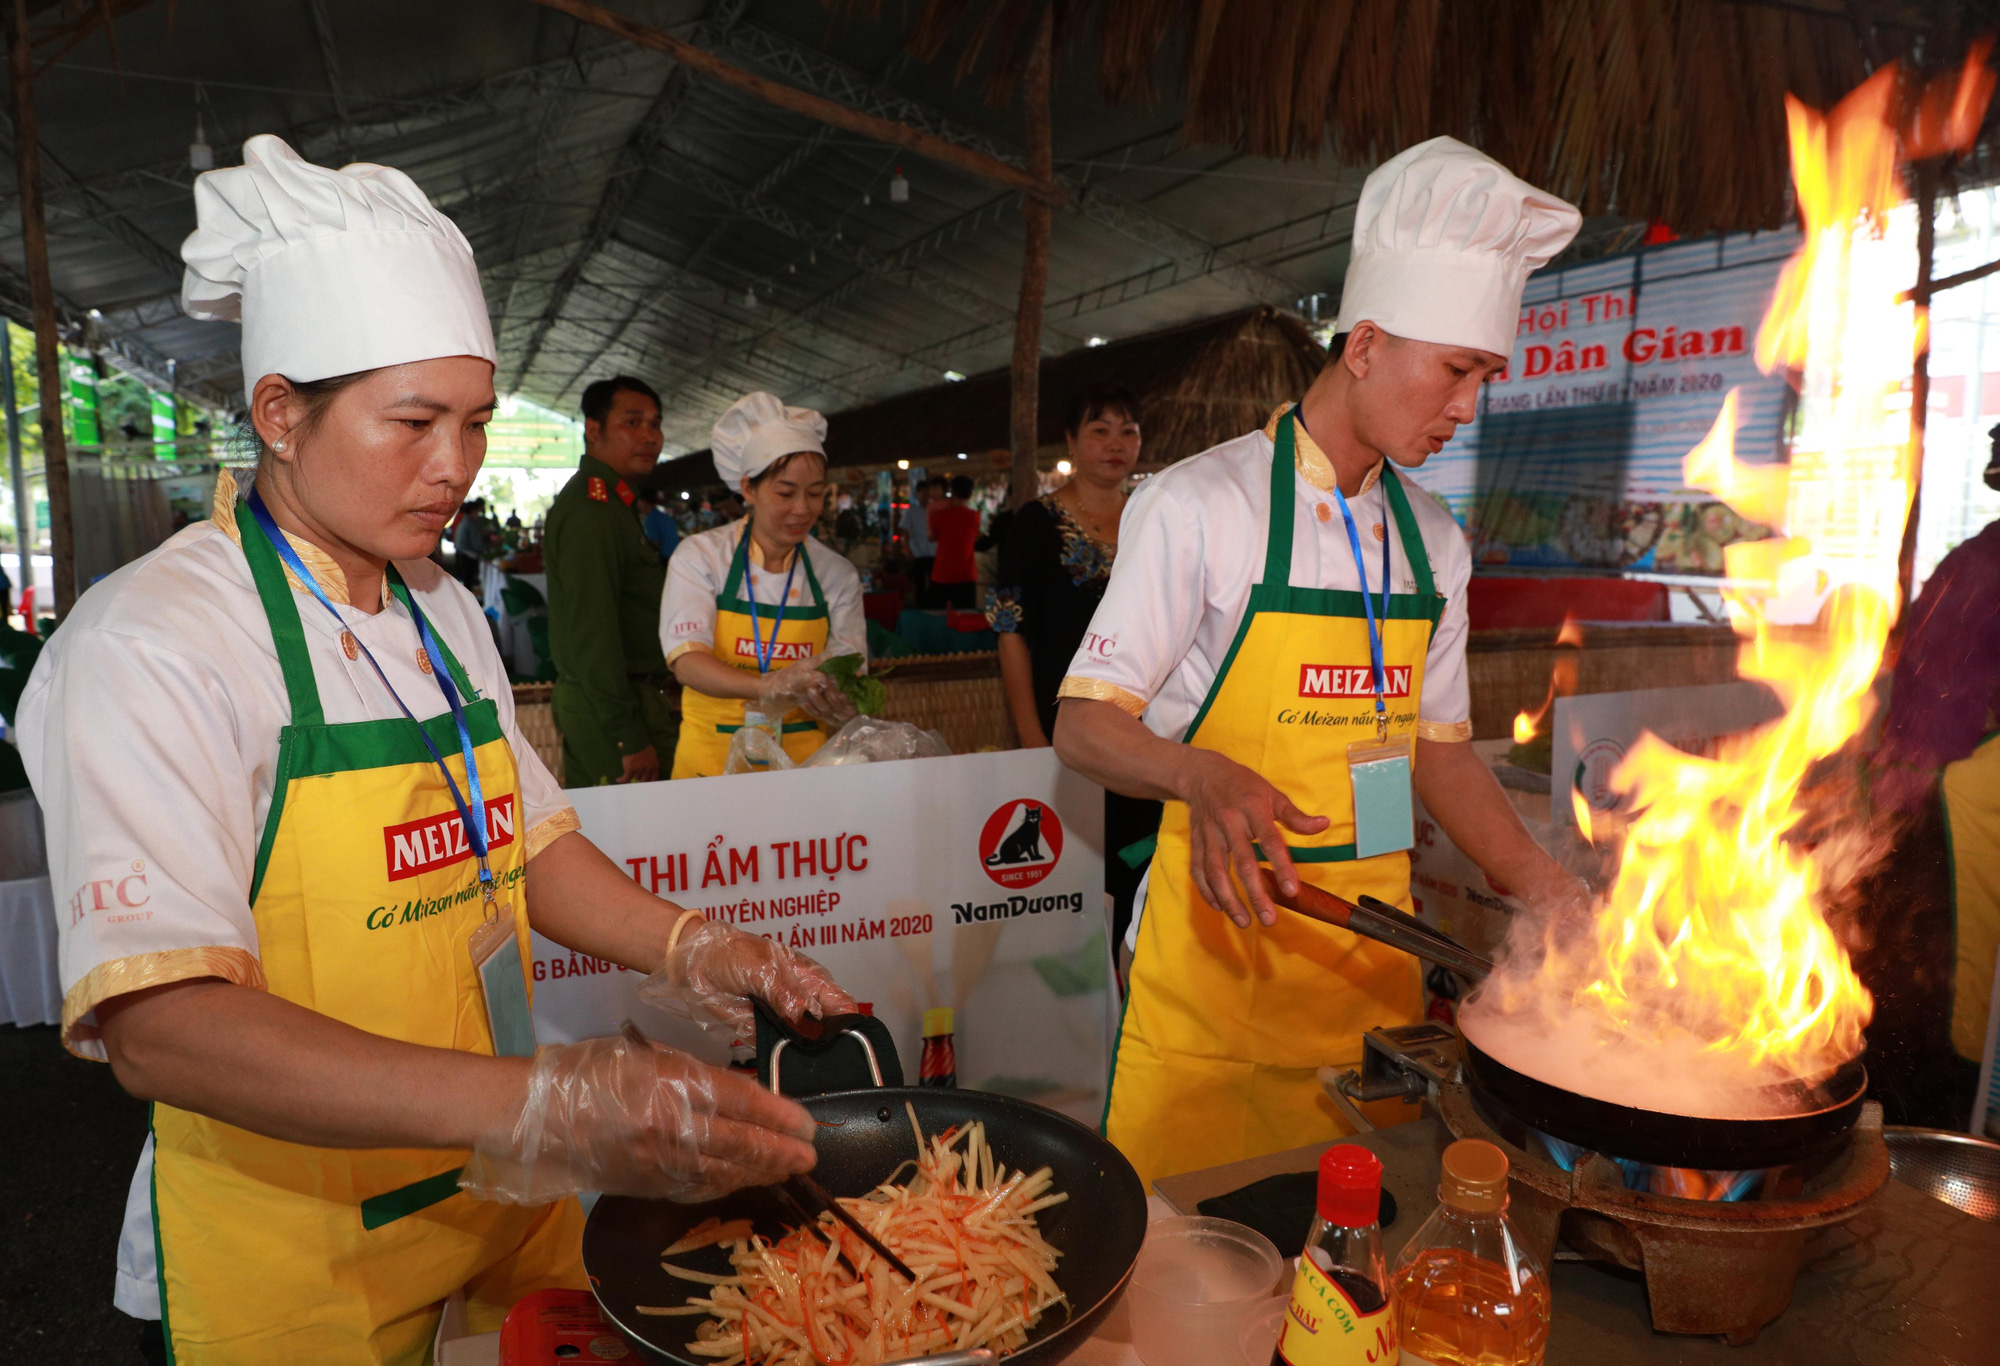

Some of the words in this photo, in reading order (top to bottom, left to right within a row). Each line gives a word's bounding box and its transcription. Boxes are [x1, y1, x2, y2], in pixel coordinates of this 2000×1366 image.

[1580, 286, 1636, 324] Thi
[1522, 340, 1606, 379] Dân
[1622, 325, 1747, 364] Gian
[1679, 373, 1724, 395] 2020
[1277, 709, 1301, 725] Có
[1300, 711, 1349, 726] Meizan
[1352, 710, 1374, 726] nấu
[1395, 712, 1416, 728] ngay
[392, 802, 514, 872] MEIZN
[626, 852, 688, 895] THI
[701, 834, 759, 889] ẨM
[770, 832, 868, 882] THỰC
[1001, 871, 1024, 883] SINCE
[1026, 870, 1043, 879] 1951
[69, 874, 151, 929] HTC
[107, 911, 154, 924] GROUP
[366, 904, 398, 931] Có
[455, 877, 479, 905] nấu
[770, 889, 841, 919] NGHIỆP
[820, 924, 837, 945] III
[841, 917, 885, 943] NĂM
[889, 914, 933, 938] 2020
[1327, 1298, 1355, 1334] CƠM
